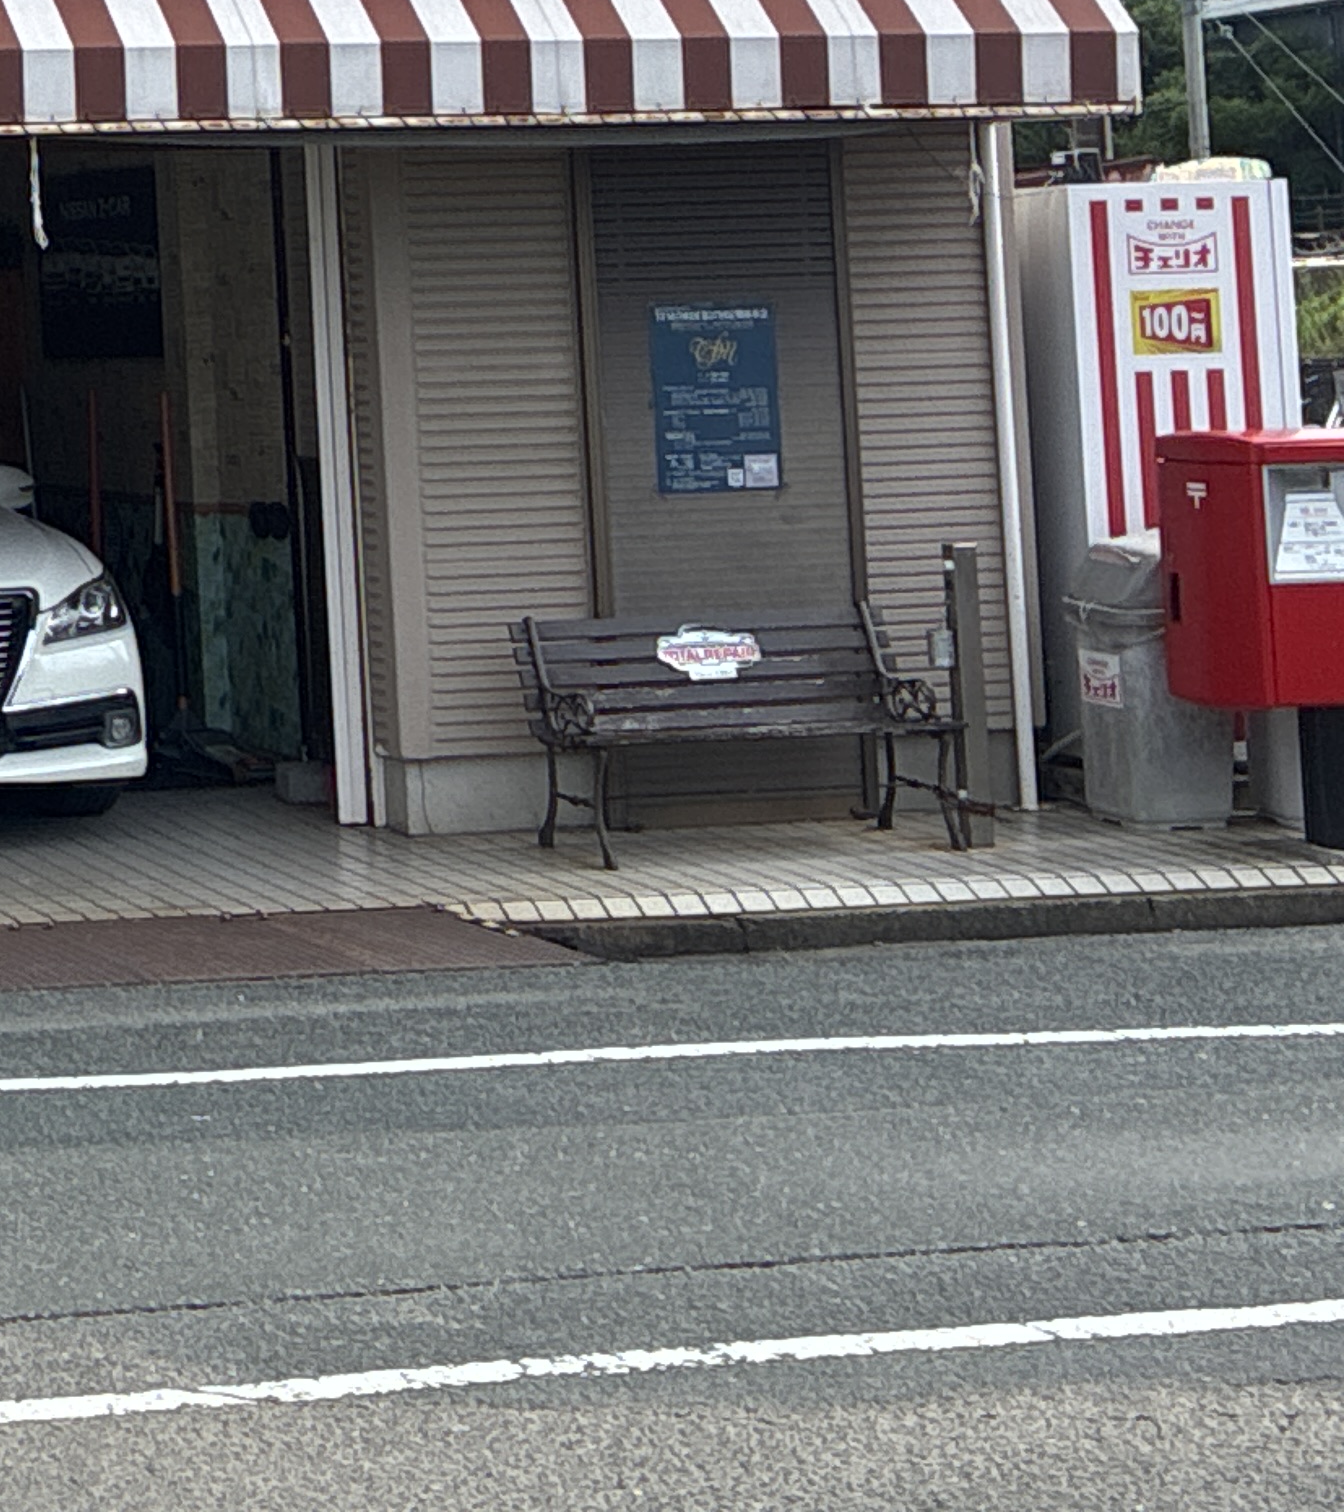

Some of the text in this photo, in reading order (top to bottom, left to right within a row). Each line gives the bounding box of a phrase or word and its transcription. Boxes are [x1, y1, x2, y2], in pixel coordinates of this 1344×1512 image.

[1134, 243, 1211, 270] チェリオ
[1142, 304, 1189, 341] 100
